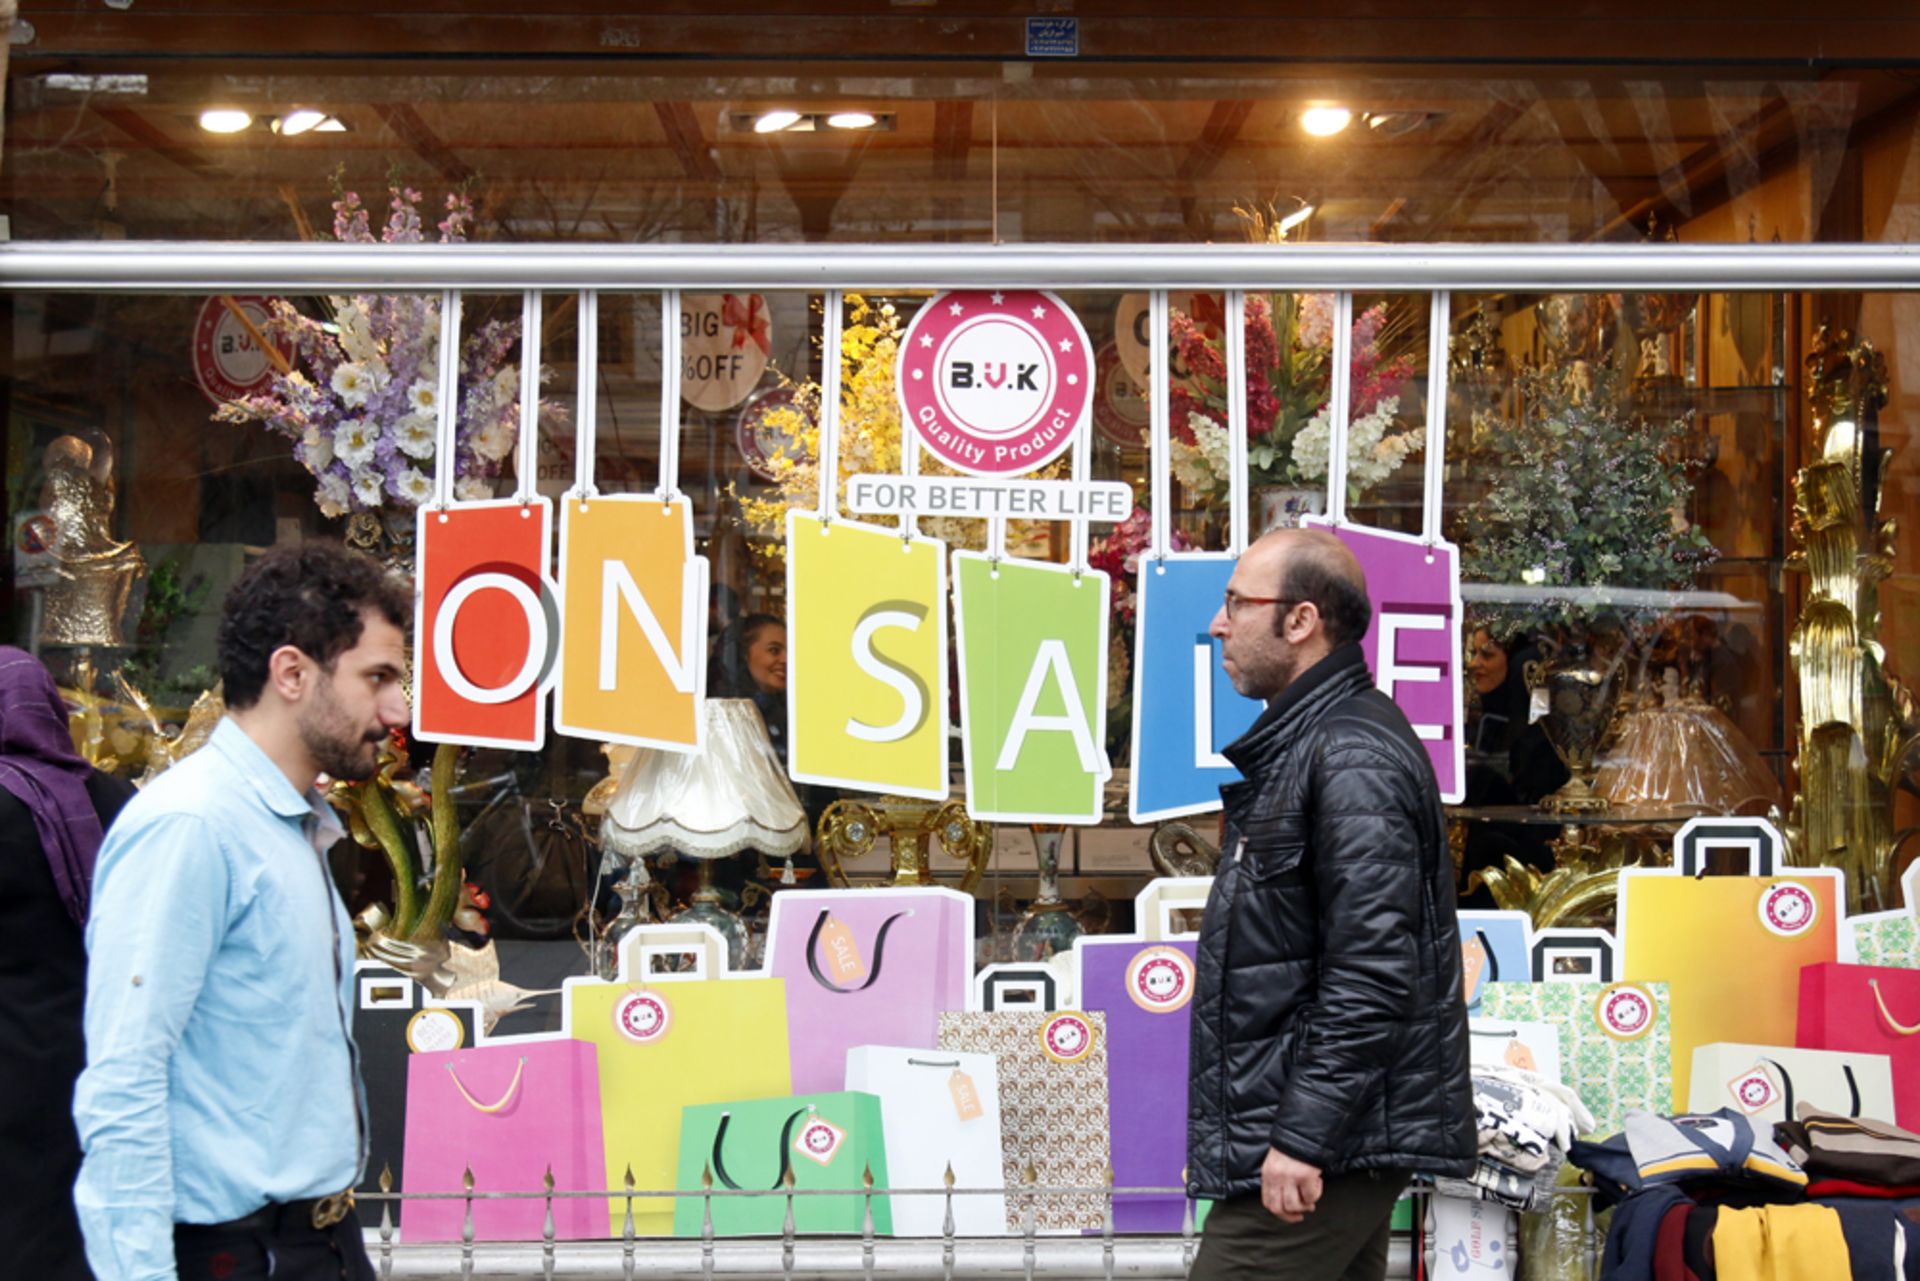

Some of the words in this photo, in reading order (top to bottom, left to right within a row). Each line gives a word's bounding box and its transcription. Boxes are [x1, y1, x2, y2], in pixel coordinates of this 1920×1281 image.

[918, 405, 986, 464] Quality
[994, 407, 1072, 463] Product
[856, 483, 918, 509] FOR
[928, 485, 1047, 514] BETTER
[1057, 490, 1125, 516] LIFE
[433, 559, 700, 705] ON
[844, 610, 1447, 774] SALE
[831, 935, 857, 974] SALE
